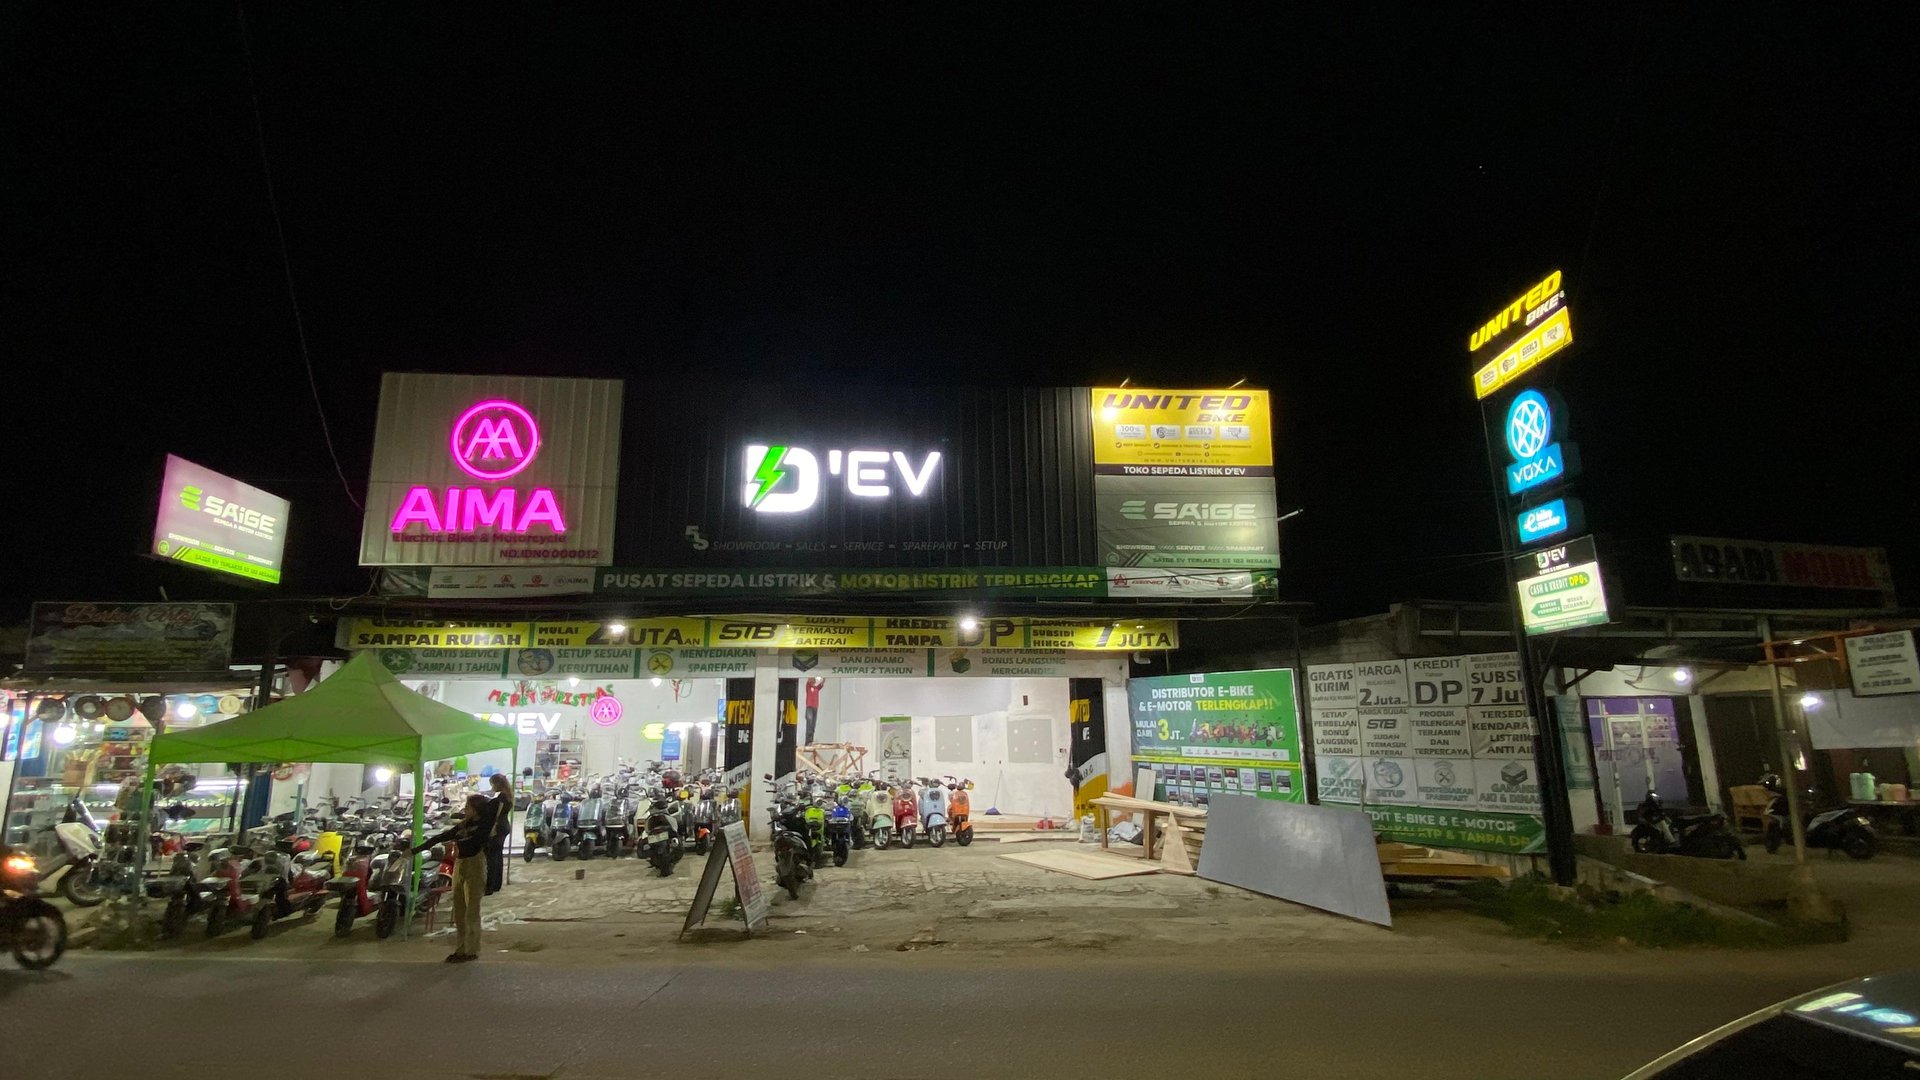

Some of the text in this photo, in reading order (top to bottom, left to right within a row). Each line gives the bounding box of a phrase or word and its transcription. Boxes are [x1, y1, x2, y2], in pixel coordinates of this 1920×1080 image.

[1469, 270, 1562, 351] UNITED
[1525, 293, 1560, 326] BIKE
[1103, 393, 1252, 411] UNITED
[1197, 413, 1246, 423] BIKE
[1124, 466, 1246, 476] TOKO SEPEDA LISTRIK D'EV
[744, 444, 941, 513] D'EV
[390, 486, 567, 533] AIMA
[392, 533, 442, 543] Electric
[447, 533, 478, 543] Bike
[493, 533, 567, 545] Motorcycle
[713, 540, 1008, 551] SHOWROOM SALES SERVICE SPAREPART SETUP
[602, 573, 668, 588] PUSAT
[671, 573, 744, 588] SEPEDA
[748, 573, 818, 588] LISTRIK
[821, 574, 837, 588] &
[840, 573, 911, 589] MOTOR
[912, 573, 979, 589] LISTRIK
[983, 573, 1099, 589] TERLENGKAP
[1530, 584, 1544, 596] CASH
[1549, 577, 1569, 591] KREDIT
[804, 617, 846, 625] SUDAH
[885, 618, 948, 630] KREDIT
[538, 626, 579, 635] MULAI
[718, 623, 777, 640] STB
[793, 626, 854, 635] TERMASUK
[1031, 629, 1075, 638] SUBSIDI
[358, 633, 522, 646] SAMPAI RUMAH
[537, 638, 570, 647] DARI
[795, 637, 847, 646] BATERAI
[885, 634, 943, 647] TANPA
[1032, 639, 1075, 648] HINGGA
[1117, 632, 1173, 647] JUTA
[421, 649, 500, 658] GRATIS SERVICE
[557, 649, 632, 658] SETUP SESUAI
[679, 648, 756, 658] MENYEDIAKAN
[841, 656, 905, 664] DAN DINAMO
[982, 657, 1066, 665] BONUS LANGSUNG
[1413, 658, 1461, 670] KREDIT
[417, 662, 502, 672] SAMPAI 1 TAHUN
[558, 663, 629, 674] KEBUTUHAN
[687, 662, 748, 673] SPAREPART
[831, 666, 869, 674] SAMPAI
[879, 667, 913, 675] TAHUN
[1358, 664, 1402, 676] HARGA
[1310, 669, 1353, 681] GRATIS
[1151, 685, 1254, 699] DISTRIBUTOR E-BIKE
[1315, 681, 1350, 693] KIRIM
[1415, 680, 1463, 705] DP
[1359, 688, 1373, 706] 2
[1471, 687, 1484, 703] 7
[1138, 703, 1146, 712] &
[1147, 700, 1193, 712] E-MOTOR
[1358, 708, 1382, 716] HARGA
[1419, 710, 1455, 718] PRODUK
[1135, 720, 1157, 729] MULAI
[1157, 718, 1170, 741] 3
[1314, 720, 1357, 728] PEMBELIAN
[1366, 718, 1397, 730] STB
[1136, 729, 1153, 738] DARI
[1322, 729, 1350, 737] BONUS
[1417, 729, 1461, 737] TERJAMIN
[1430, 738, 1450, 746] DAN
[1322, 747, 1353, 755] HADIAH
[1414, 748, 1470, 756] TERPERCAYA
[1487, 745, 1515, 754] ANTI
[1320, 777, 1361, 788] GRATIS
[1375, 789, 1406, 798] SETUP
[1394, 812, 1517, 832] E-BIKE & E-MOTOR
[1446, 830, 1456, 840] &
[1459, 831, 1506, 846] TANPA
